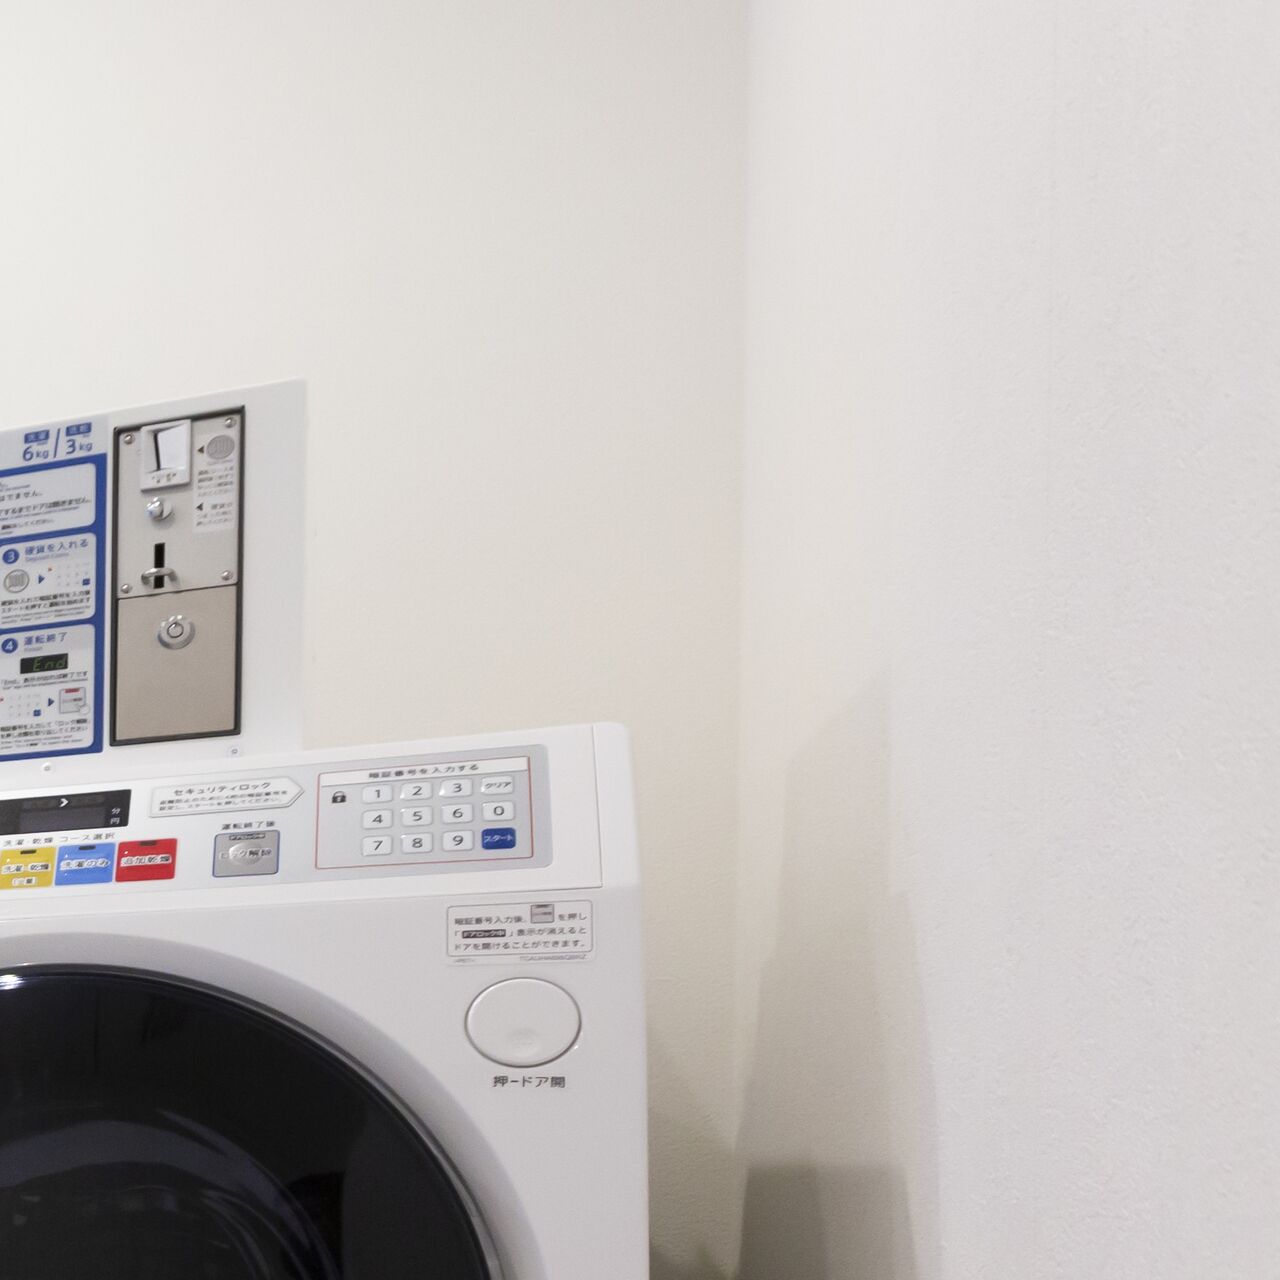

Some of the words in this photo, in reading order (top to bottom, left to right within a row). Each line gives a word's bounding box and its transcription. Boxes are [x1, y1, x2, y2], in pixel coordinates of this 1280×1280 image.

[25, 538, 89, 556] 硬貨を入れる
[24, 632, 67, 646] 運転終了
[369, 763, 480, 779] 暗証番号を入力する
[174, 782, 271, 796] セキュリティロック
[412, 786, 423, 796] 2
[452, 783, 463, 793] 3
[375, 789, 382, 799] 1
[452, 808, 463, 818] 6
[493, 805, 505, 816] 0
[372, 814, 383, 824] 4
[412, 811, 422, 822] 5
[222, 821, 275, 830] 運転終了後
[412, 838, 423, 849] 8
[452, 835, 463, 846] 9
[483, 834, 514, 843] スタート
[373, 840, 383, 851] 7
[62, 859, 110, 869] 洗濯のみ
[455, 940, 584, 950] ドアを開けることができます。
